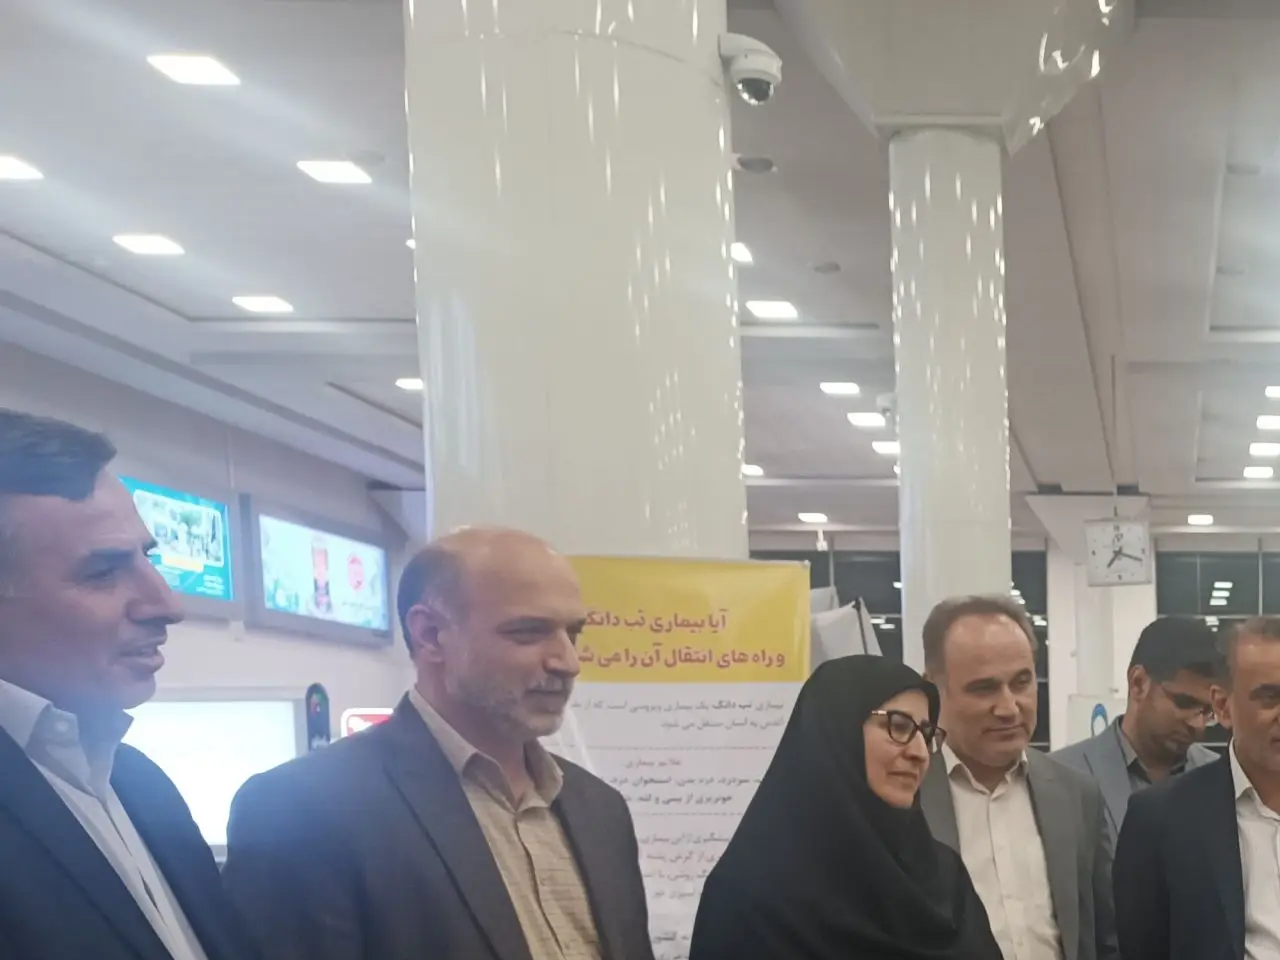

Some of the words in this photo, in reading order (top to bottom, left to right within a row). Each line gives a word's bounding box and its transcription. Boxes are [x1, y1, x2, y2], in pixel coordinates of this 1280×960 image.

[624, 608, 647, 632] تب
[650, 612, 706, 634] بیماری
[707, 608, 728, 634] آیا
[598, 652, 622, 668] می
[624, 647, 638, 668] را
[641, 642, 664, 668] آن
[664, 645, 714, 668] انتقال
[717, 647, 750, 669] های
[752, 647, 773, 668] راه
[775, 652, 786, 668] و
